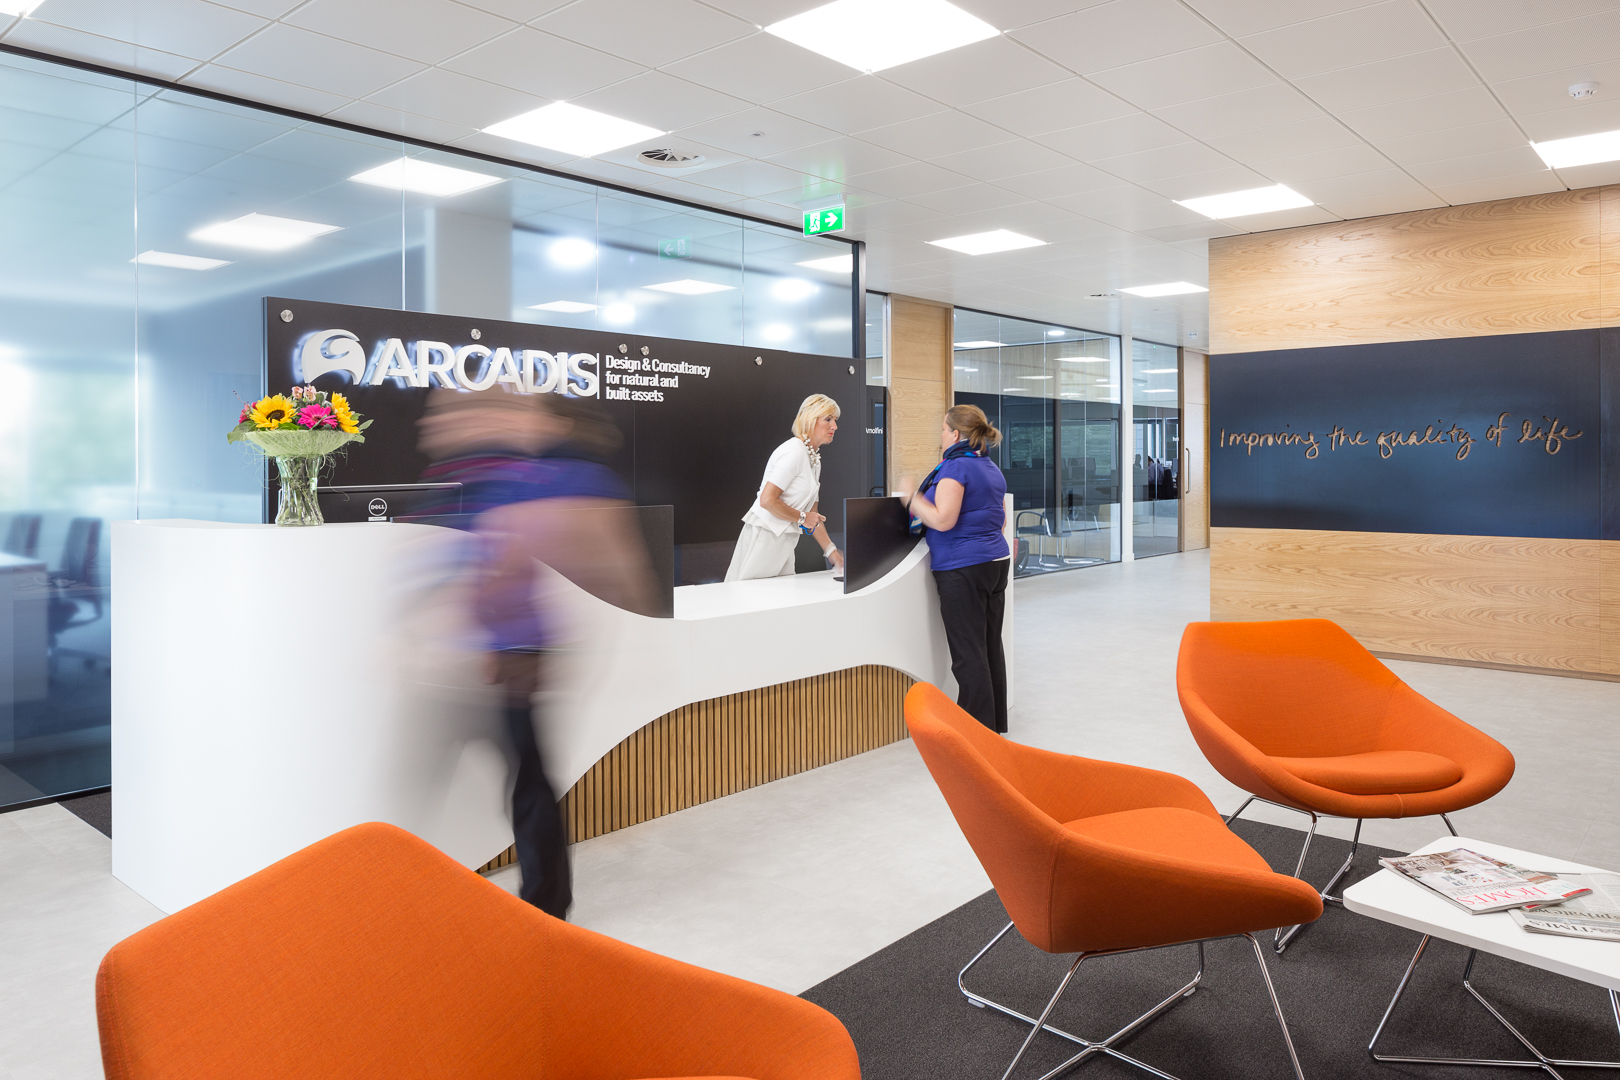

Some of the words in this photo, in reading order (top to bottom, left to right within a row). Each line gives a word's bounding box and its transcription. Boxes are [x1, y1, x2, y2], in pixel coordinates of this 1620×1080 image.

[369, 338, 598, 397] ARCADIS
[605, 354, 641, 373] Design
[641, 357, 652, 372] &
[651, 358, 711, 378] Consultancy
[605, 371, 622, 385] for
[622, 373, 660, 388] natural
[660, 375, 679, 389] and
[605, 386, 631, 401] built
[631, 389, 665, 403] assets
[1219, 424, 1320, 460] Improving
[1326, 424, 1369, 452] the
[1376, 419, 1477, 461] quality
[1485, 411, 1512, 448] of
[1517, 415, 1584, 455] life
[1456, 886, 1548, 906] HOMES
